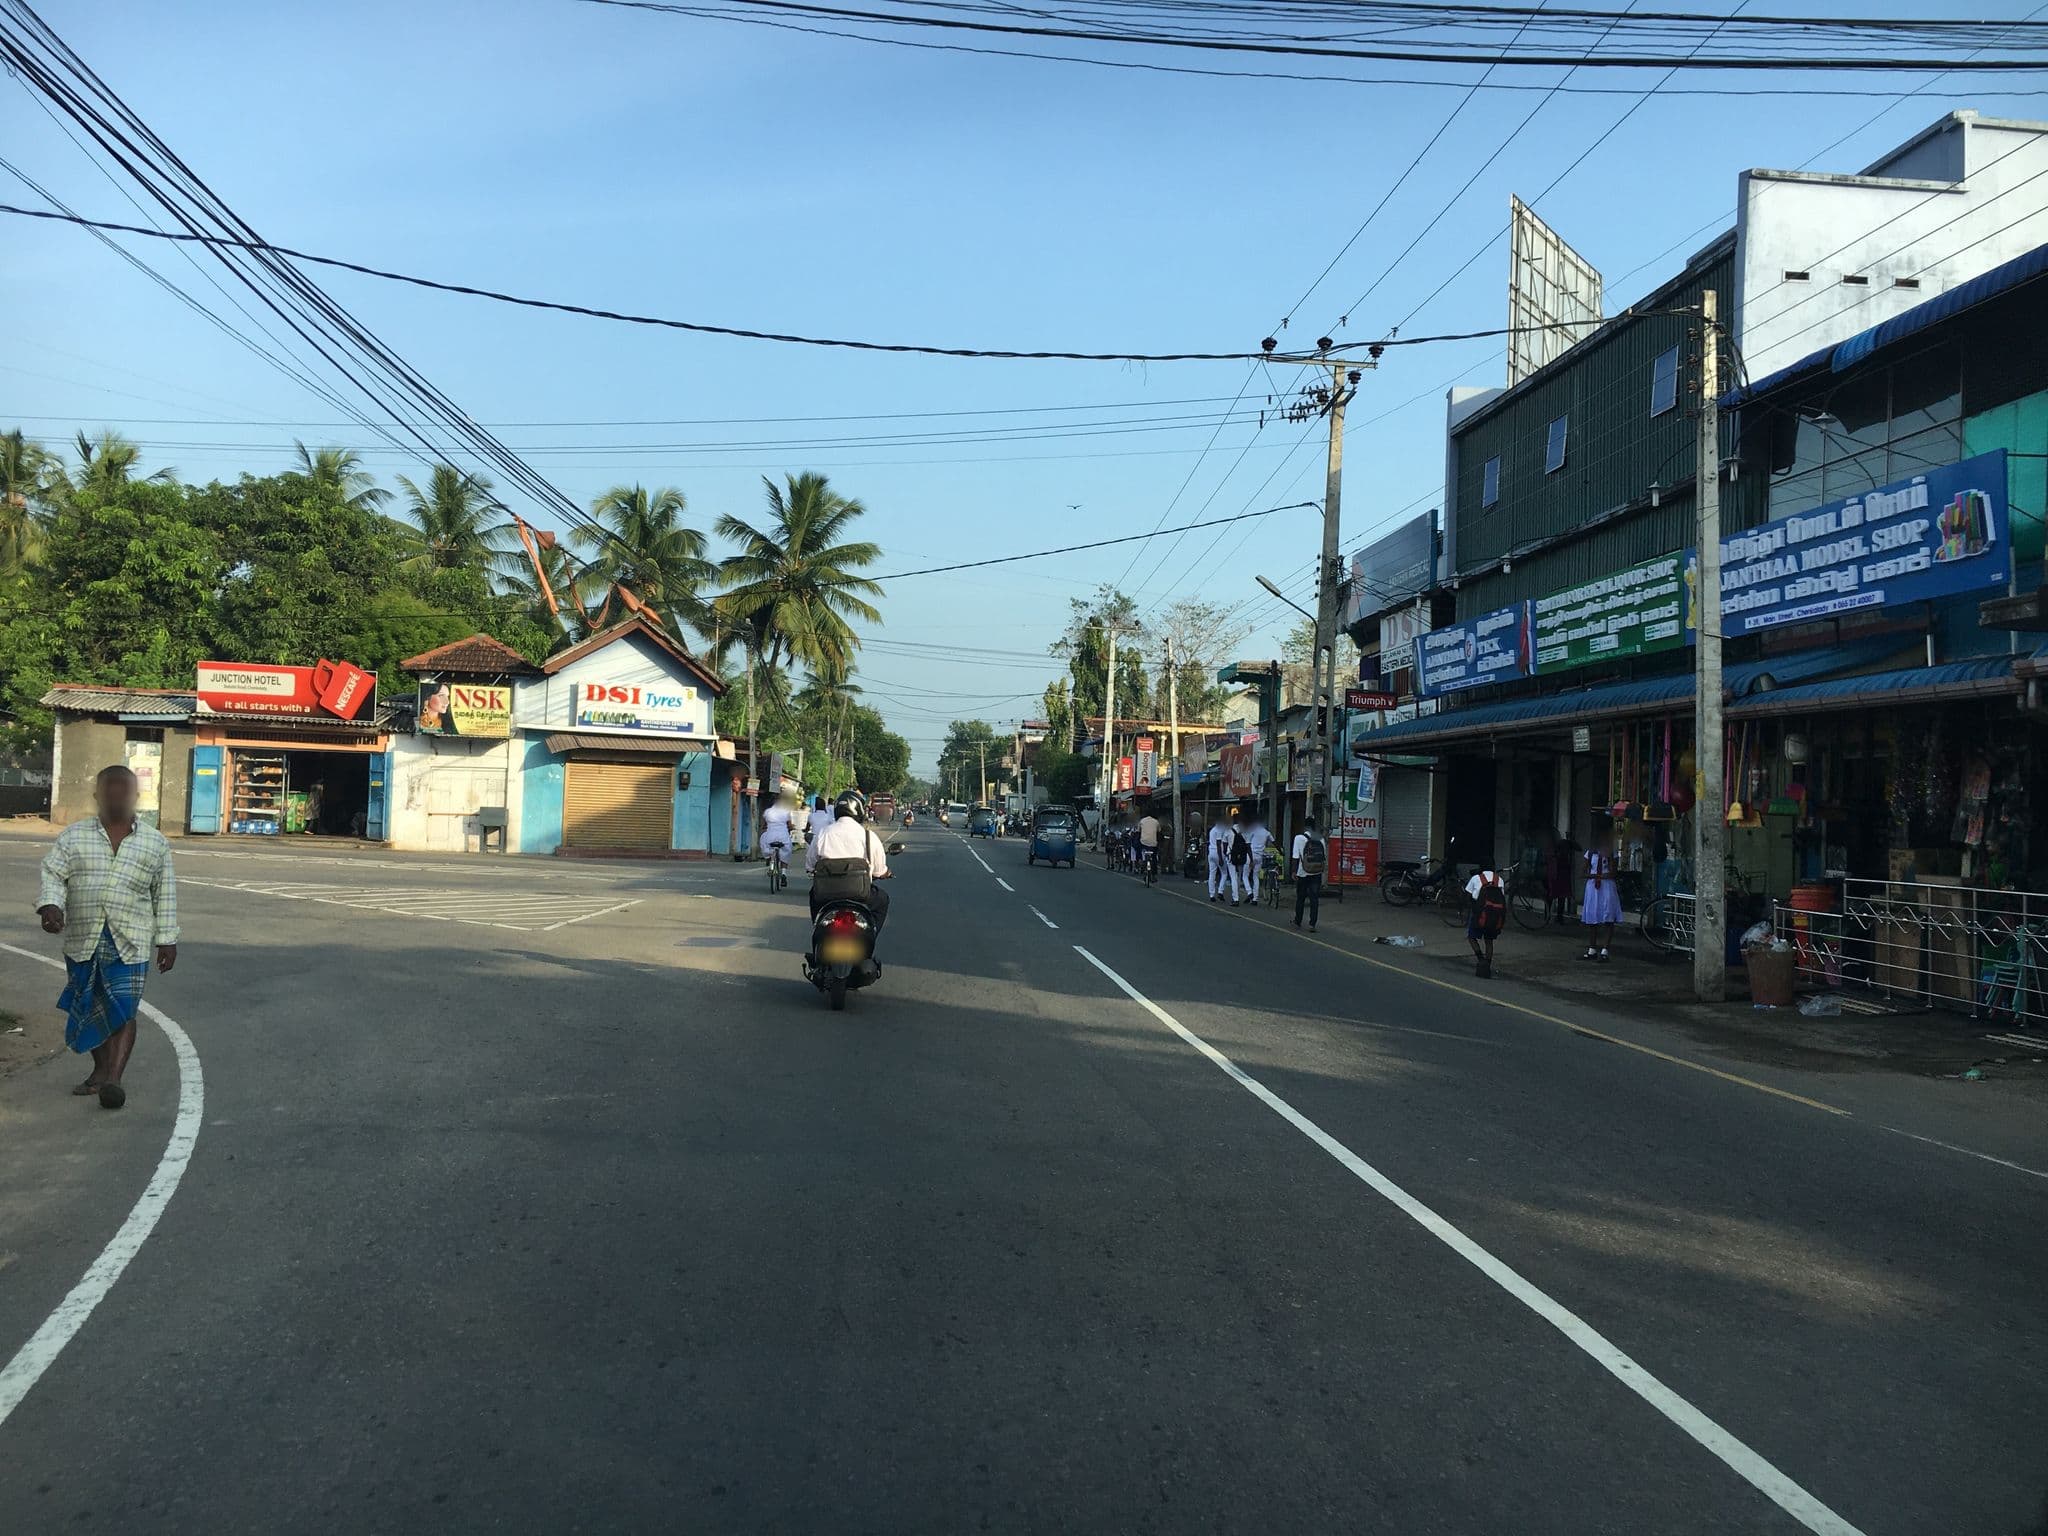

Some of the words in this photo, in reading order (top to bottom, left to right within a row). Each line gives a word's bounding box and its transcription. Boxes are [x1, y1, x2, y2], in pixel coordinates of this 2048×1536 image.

[1720, 554, 1800, 592] JANTHAA
[1801, 536, 1870, 571] MODEL
[1871, 519, 1930, 553] SHOP
[210, 673, 251, 686] JUNCTION
[255, 675, 282, 686] HOTEL
[224, 700, 232, 709] It
[234, 700, 247, 710] all
[250, 701, 279, 712] starts
[281, 702, 302, 713] with
[453, 687, 505, 710] NSK
[586, 684, 642, 705] DSI
[645, 692, 683, 708] Tyres
[1350, 695, 1386, 709] Triumph
[1141, 752, 1150, 776] Dialog
